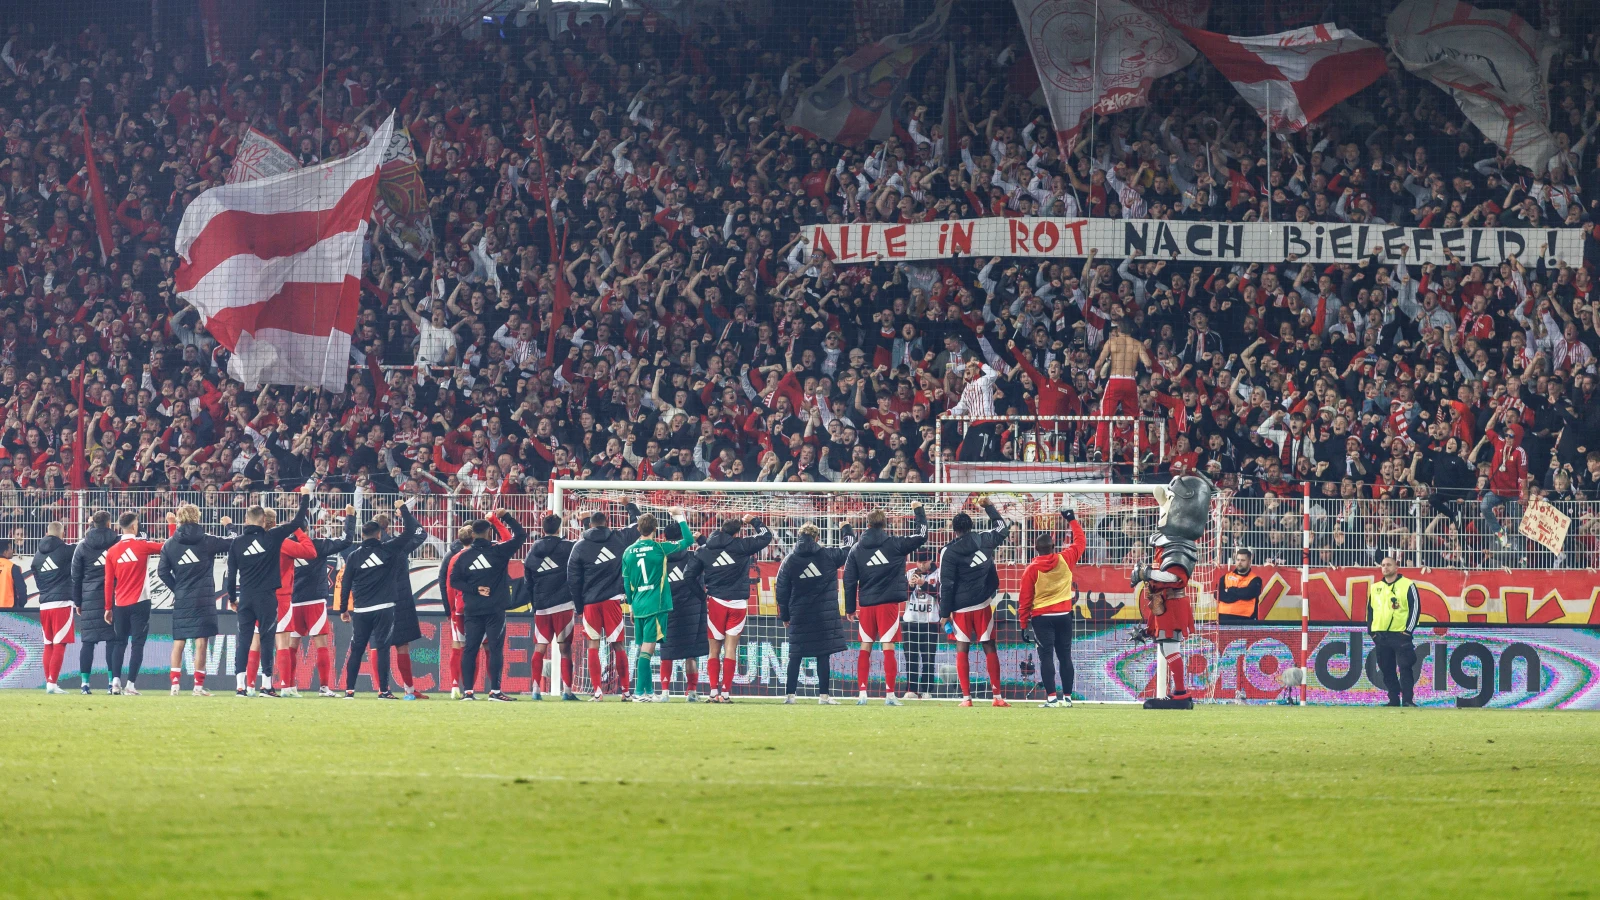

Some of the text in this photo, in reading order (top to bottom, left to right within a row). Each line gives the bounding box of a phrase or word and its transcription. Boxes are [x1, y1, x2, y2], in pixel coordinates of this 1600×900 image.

[814, 223, 907, 260] ALLE
[1009, 219, 1088, 256] ROT
[1125, 221, 1243, 258] NACH
[637, 557, 649, 584] 1
[909, 602, 933, 613] CLUB
